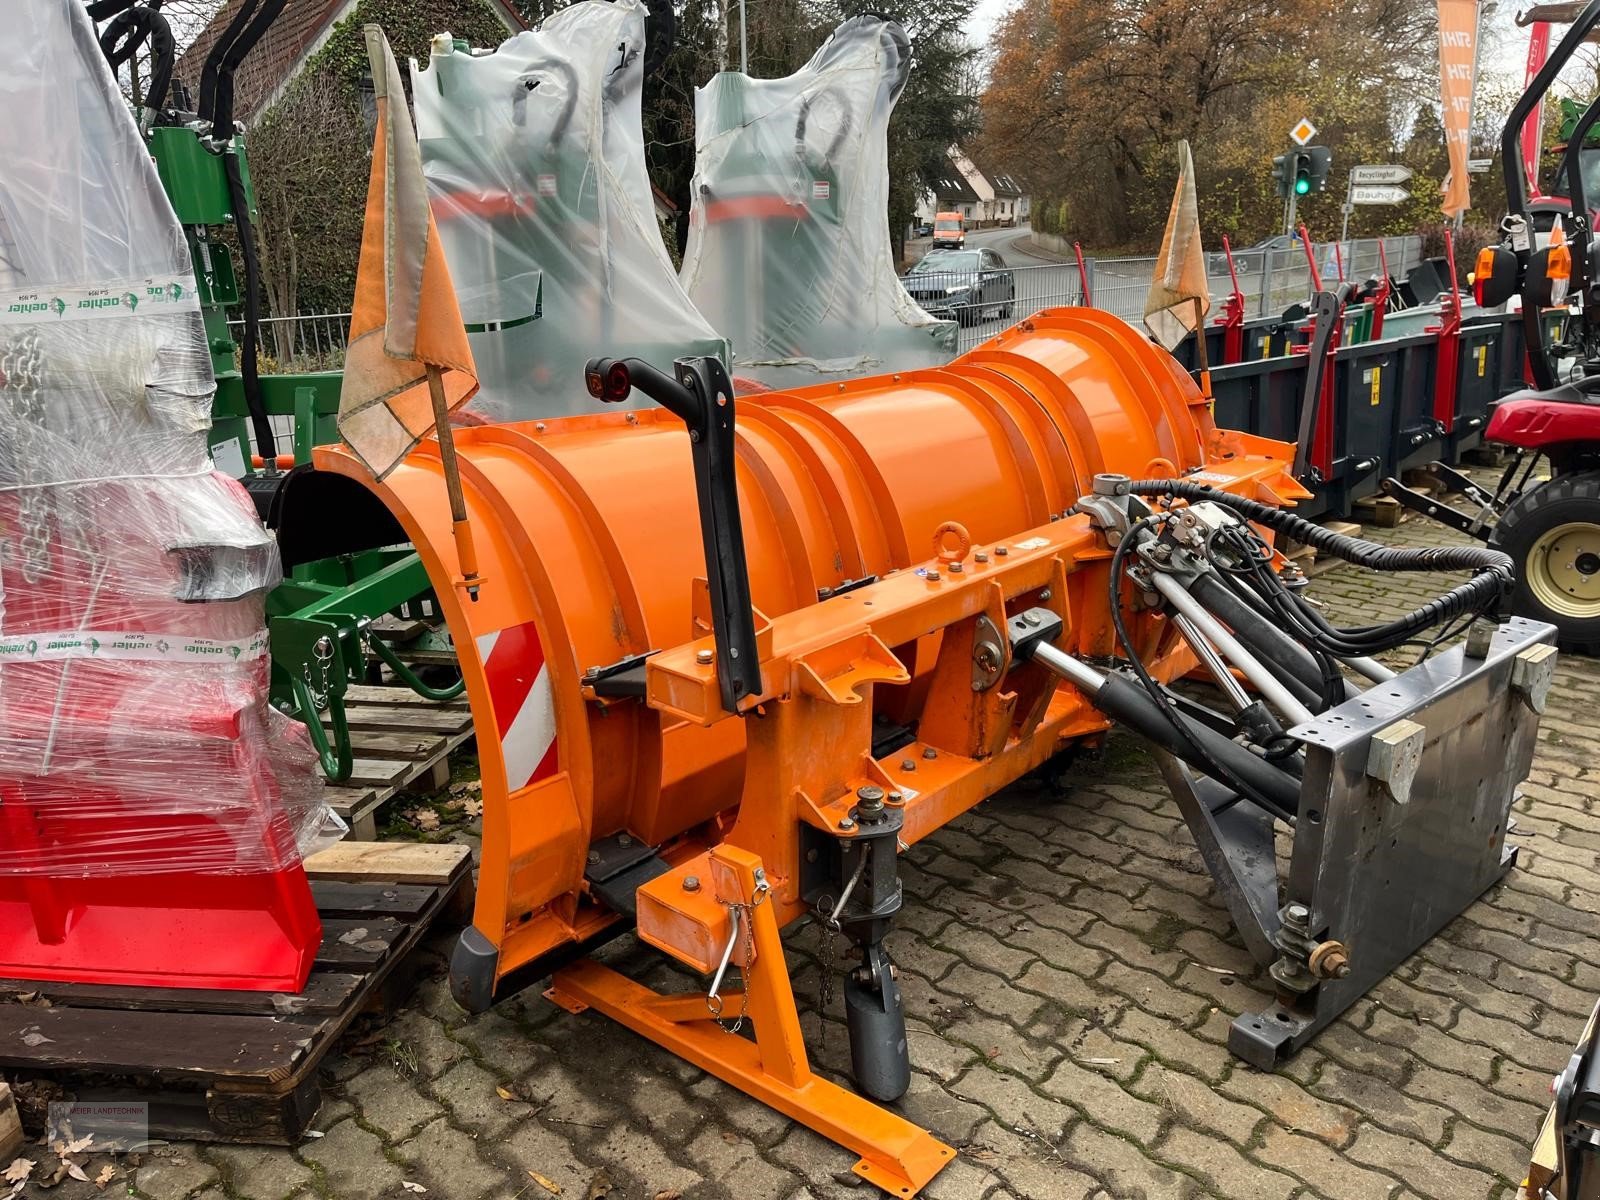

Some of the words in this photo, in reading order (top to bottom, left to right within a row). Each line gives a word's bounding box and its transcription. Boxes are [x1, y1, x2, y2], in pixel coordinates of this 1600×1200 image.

[1358, 171, 1396, 180] Recyclinghof
[1356, 190, 1394, 199] Bauhof
[7, 302, 48, 313] oehler
[77, 297, 119, 309] oehler
